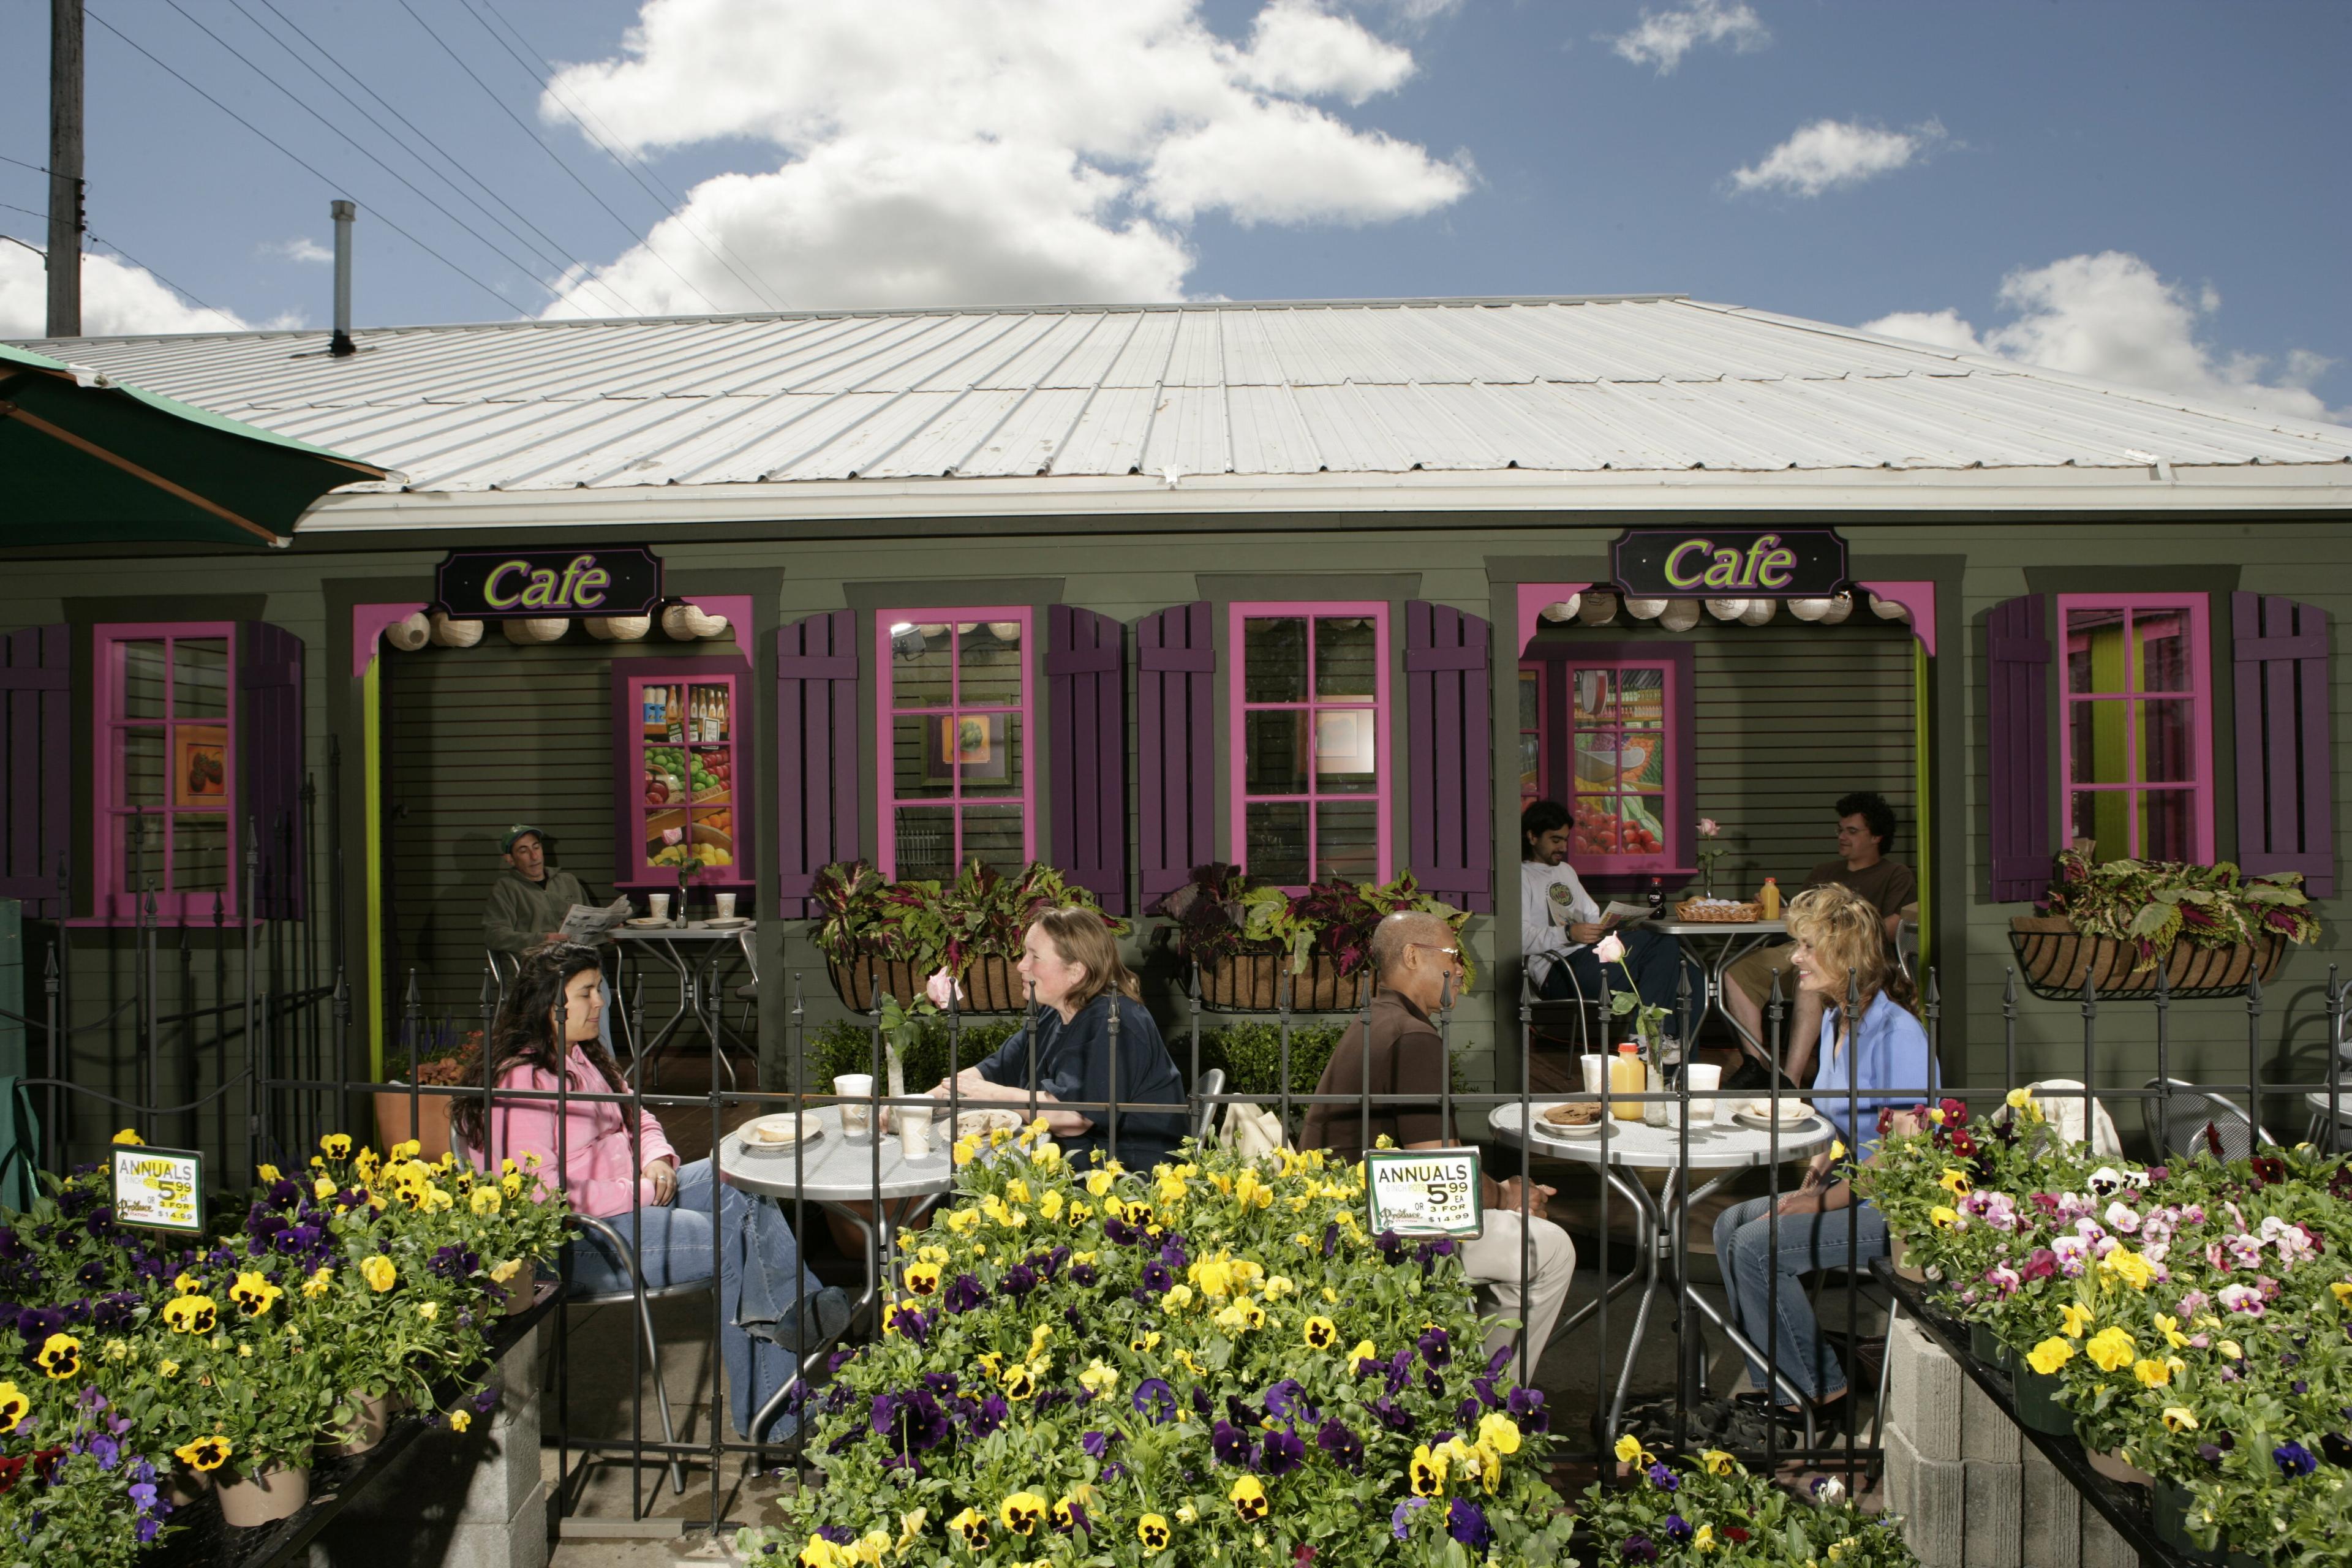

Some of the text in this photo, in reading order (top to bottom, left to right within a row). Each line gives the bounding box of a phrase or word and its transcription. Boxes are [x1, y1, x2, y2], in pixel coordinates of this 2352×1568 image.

[119, 1159, 192, 1181] ANNUALS
[1379, 1164, 1468, 1183] ANNUALS
[1379, 1207, 1422, 1228] Produce
[1428, 1213, 1469, 1223] $14.99
